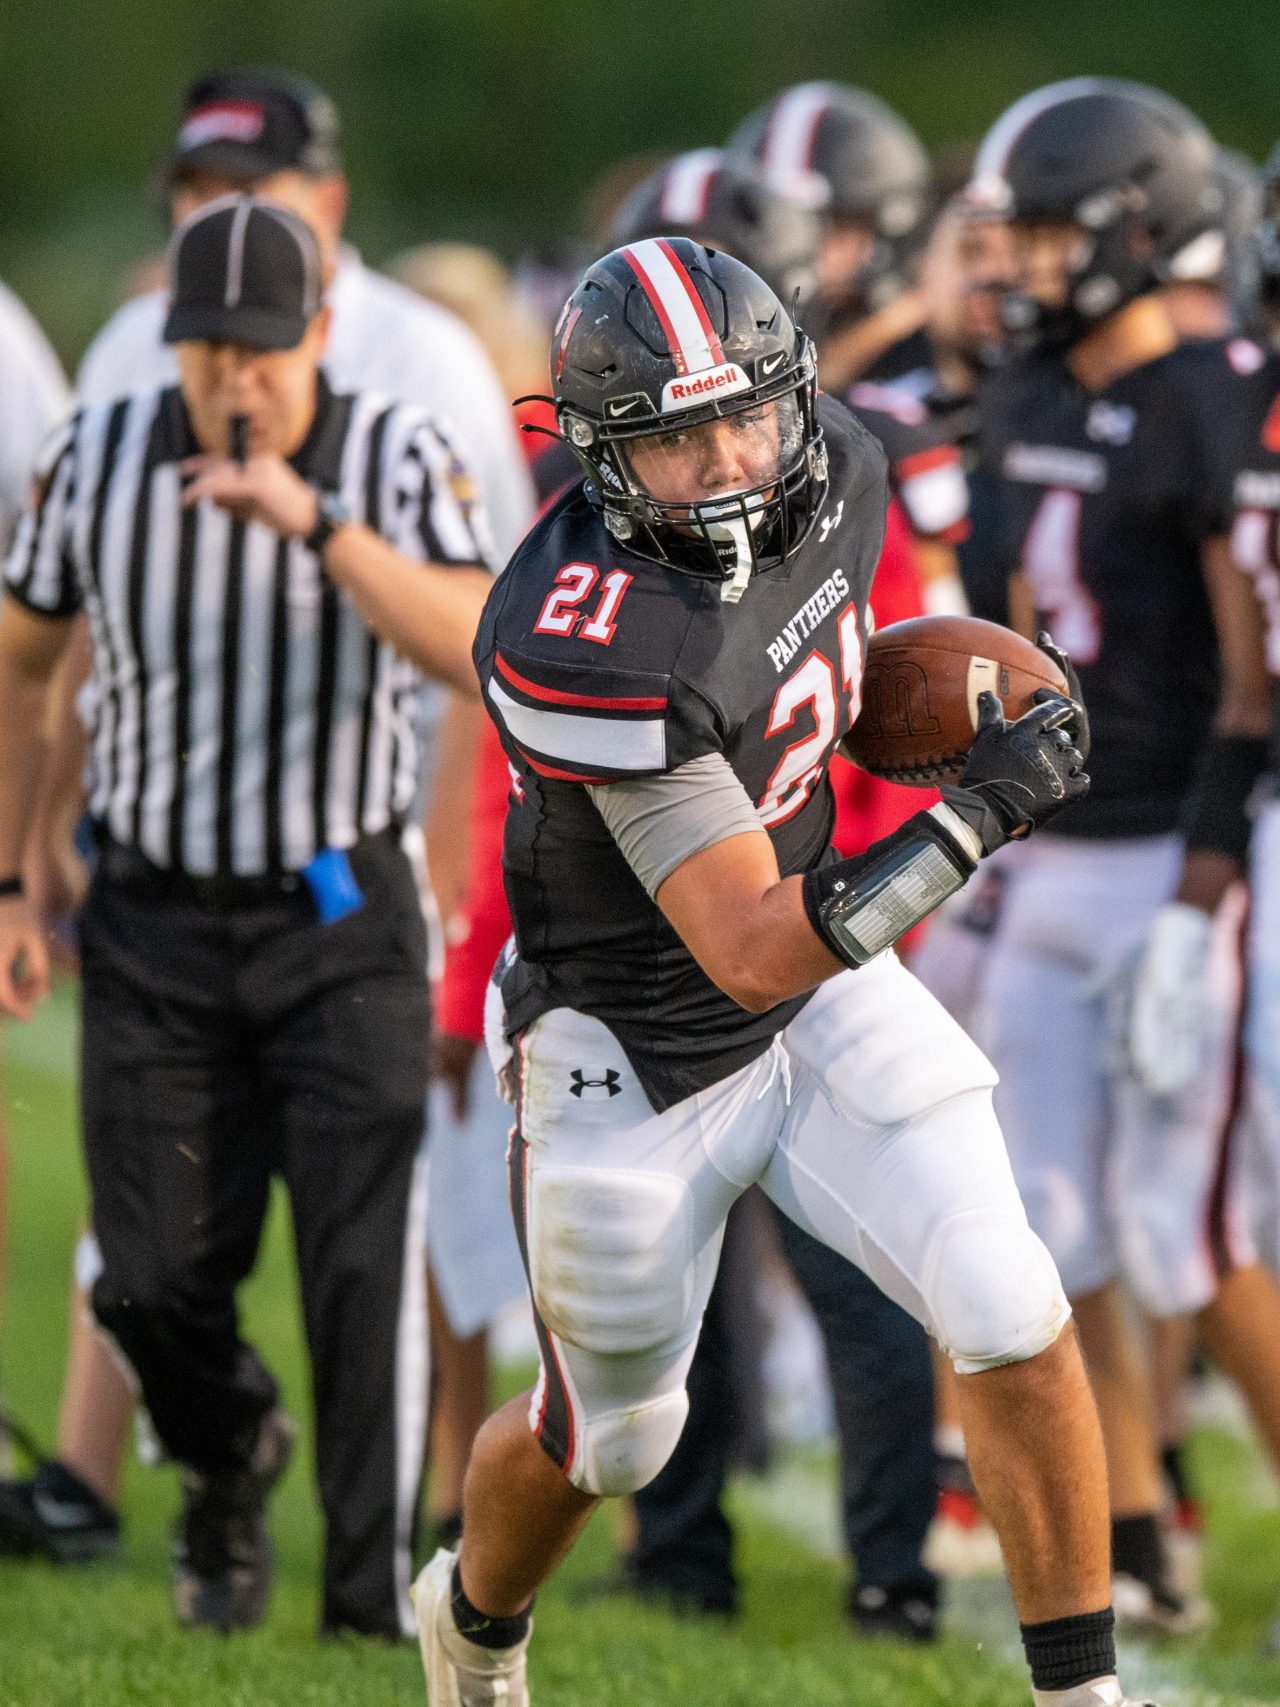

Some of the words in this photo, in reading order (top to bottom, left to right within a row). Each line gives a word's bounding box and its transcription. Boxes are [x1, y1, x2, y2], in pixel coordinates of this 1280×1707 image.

[671, 367, 738, 400] Riddell
[532, 561, 635, 646] 21
[766, 568, 850, 673] PANTHERS
[756, 600, 864, 830] 21
